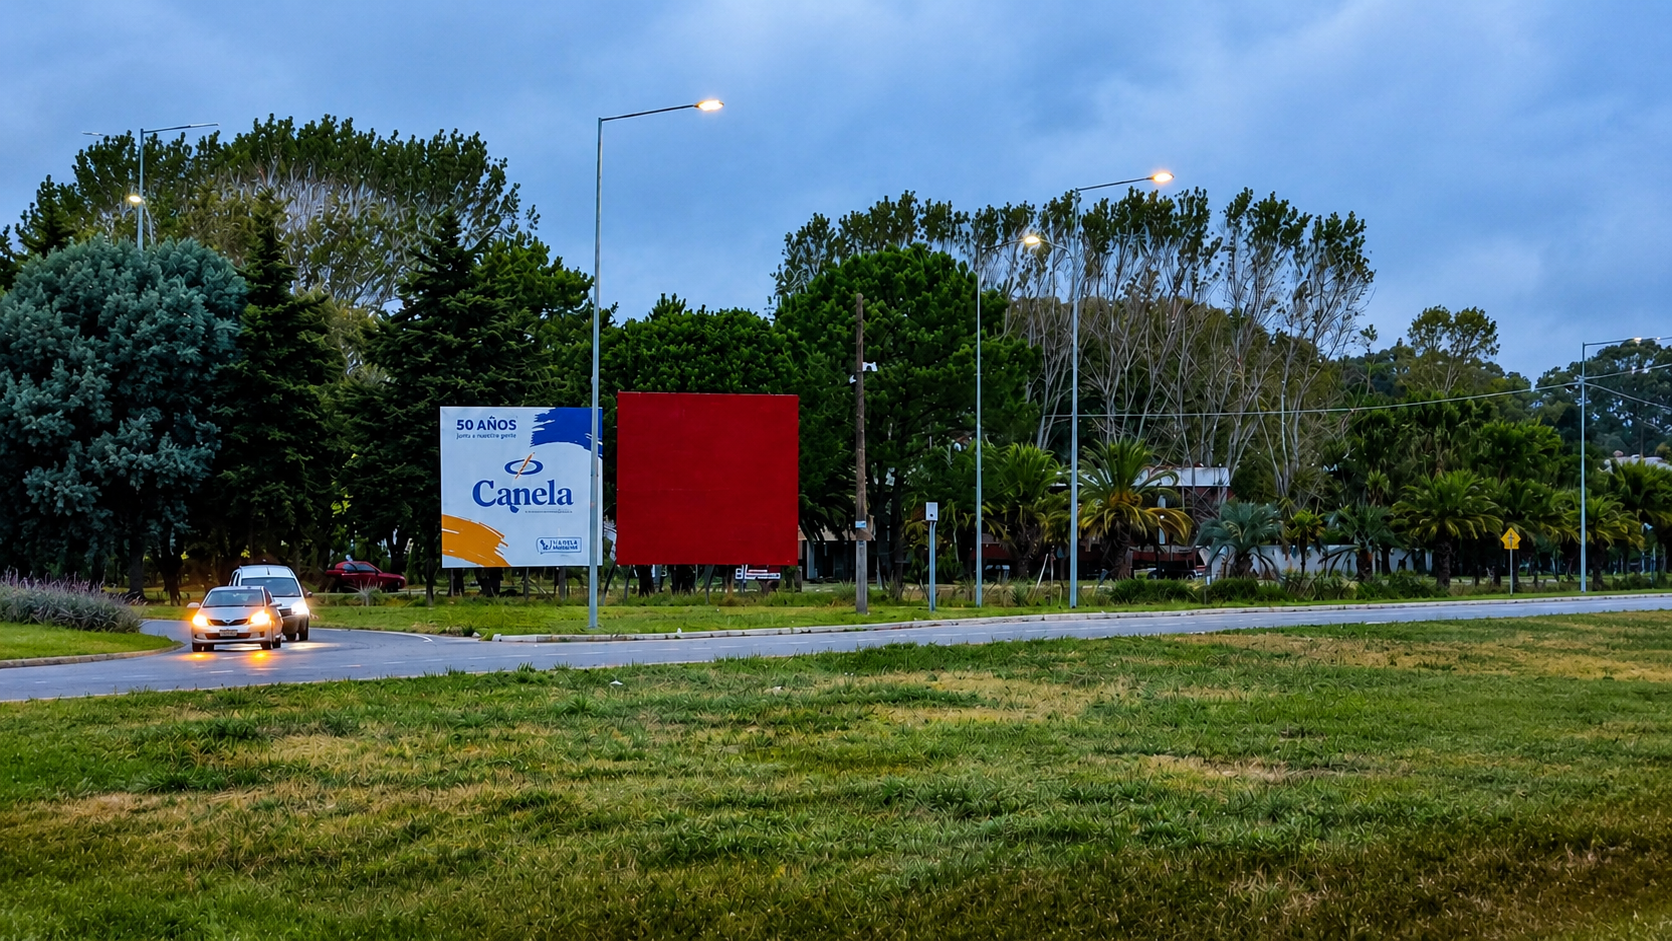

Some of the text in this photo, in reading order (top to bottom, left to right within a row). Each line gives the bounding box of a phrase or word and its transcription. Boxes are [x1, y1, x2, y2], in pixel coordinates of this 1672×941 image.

[456, 415, 517, 431] 50 AÑOS
[472, 479, 575, 513] Canela
